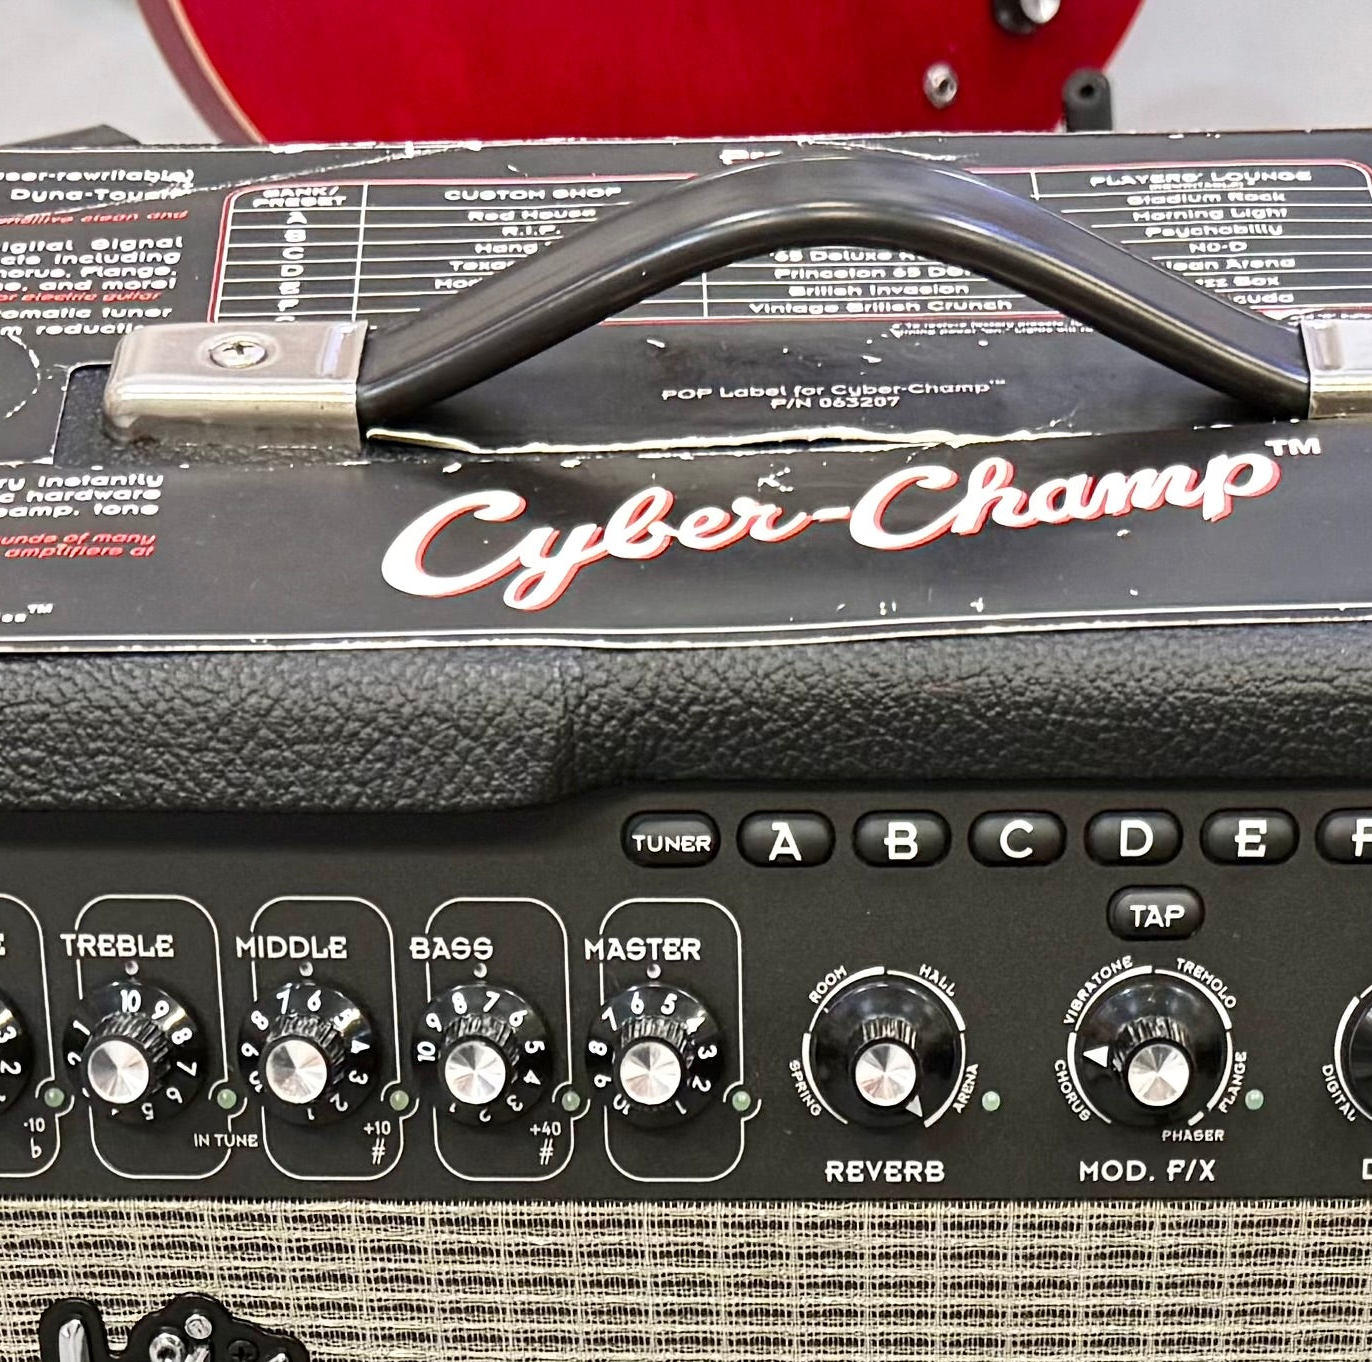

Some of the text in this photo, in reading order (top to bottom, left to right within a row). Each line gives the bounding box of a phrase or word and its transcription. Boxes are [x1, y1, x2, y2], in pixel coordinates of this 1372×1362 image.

[661, 388, 713, 401] POP
[719, 385, 787, 399] Label
[793, 383, 826, 397] for
[770, 395, 900, 410] P/N 063207
[632, 833, 711, 853] TUNER
[768, 821, 802, 862] A
[883, 821, 919, 861] B
[1000, 819, 1035, 859] C
[1119, 819, 1154, 858] D
[1234, 818, 1268, 859] E
[1129, 904, 1186, 929] TAP
[60, 933, 174, 958] TREBLE
[235, 935, 348, 960] MIDDLE
[409, 936, 494, 960] BASS
[585, 938, 701, 961] MASTER
[809, 965, 848, 1004] ROOM
[918, 964, 956, 998] HALL
[1063, 955, 1133, 1026] VIBRATONE
[1176, 957, 1237, 1009] TREMOLO
[789, 1059, 823, 1117] SPRING
[952, 1063, 979, 1114] ARENA
[1053, 1059, 1091, 1122] CHORUS
[1217, 1050, 1248, 1114] FLANGE
[1321, 1064, 1357, 1122] DIGITAL
[193, 1133, 259, 1148] IN TUNE
[363, 1120, 391, 1136] +10
[529, 1121, 562, 1137] +40
[1161, 1129, 1225, 1142] PHASER
[824, 1160, 945, 1183] REVERB
[1079, 1159, 1217, 1182] MOD. F/X
